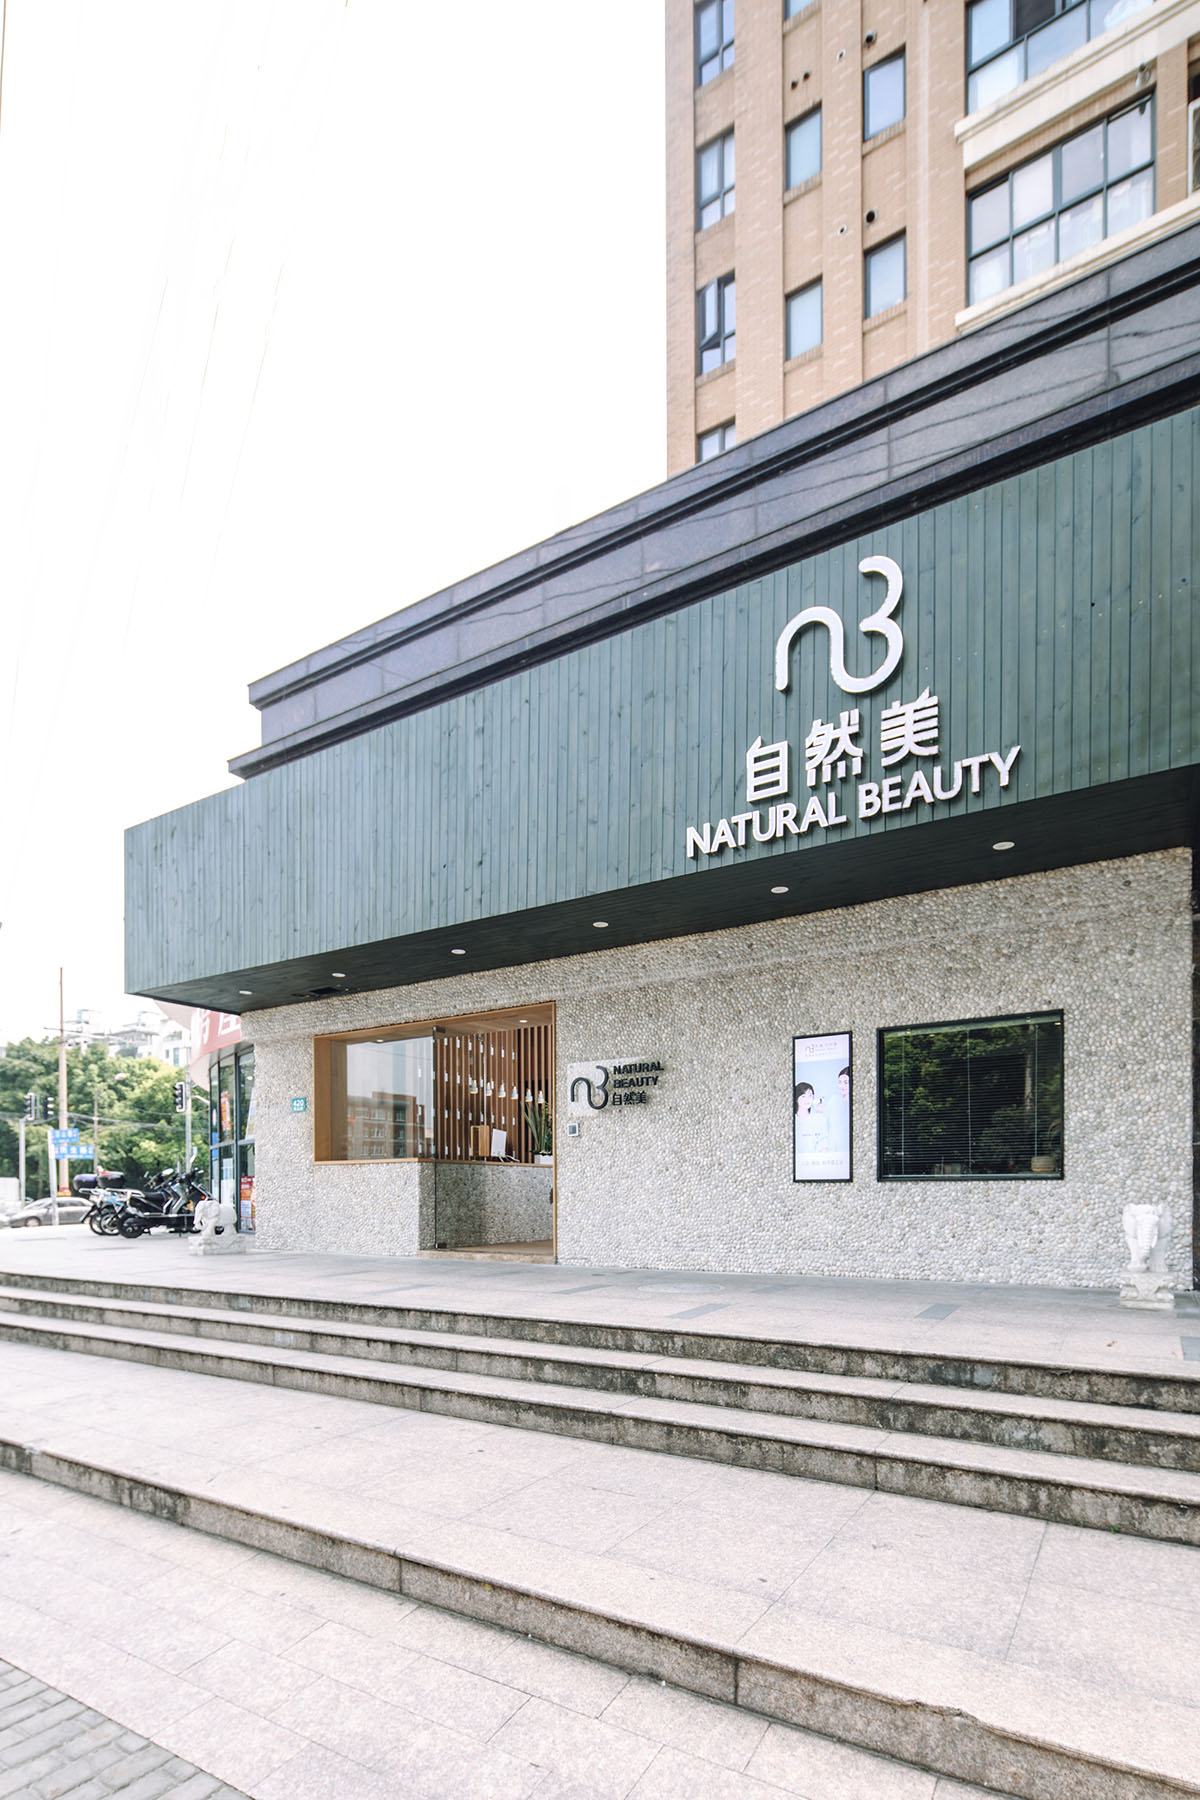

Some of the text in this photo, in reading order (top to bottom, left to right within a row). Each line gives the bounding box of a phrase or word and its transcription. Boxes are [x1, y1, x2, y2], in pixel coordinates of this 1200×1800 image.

[746, 686, 939, 803] 自然美
[686, 745, 1022, 859] NATURAL BEAUTY
[613, 1061, 664, 1075] NATURAL
[613, 1076, 659, 1089] BEAUTY
[612, 1090, 647, 1106] 自然美
